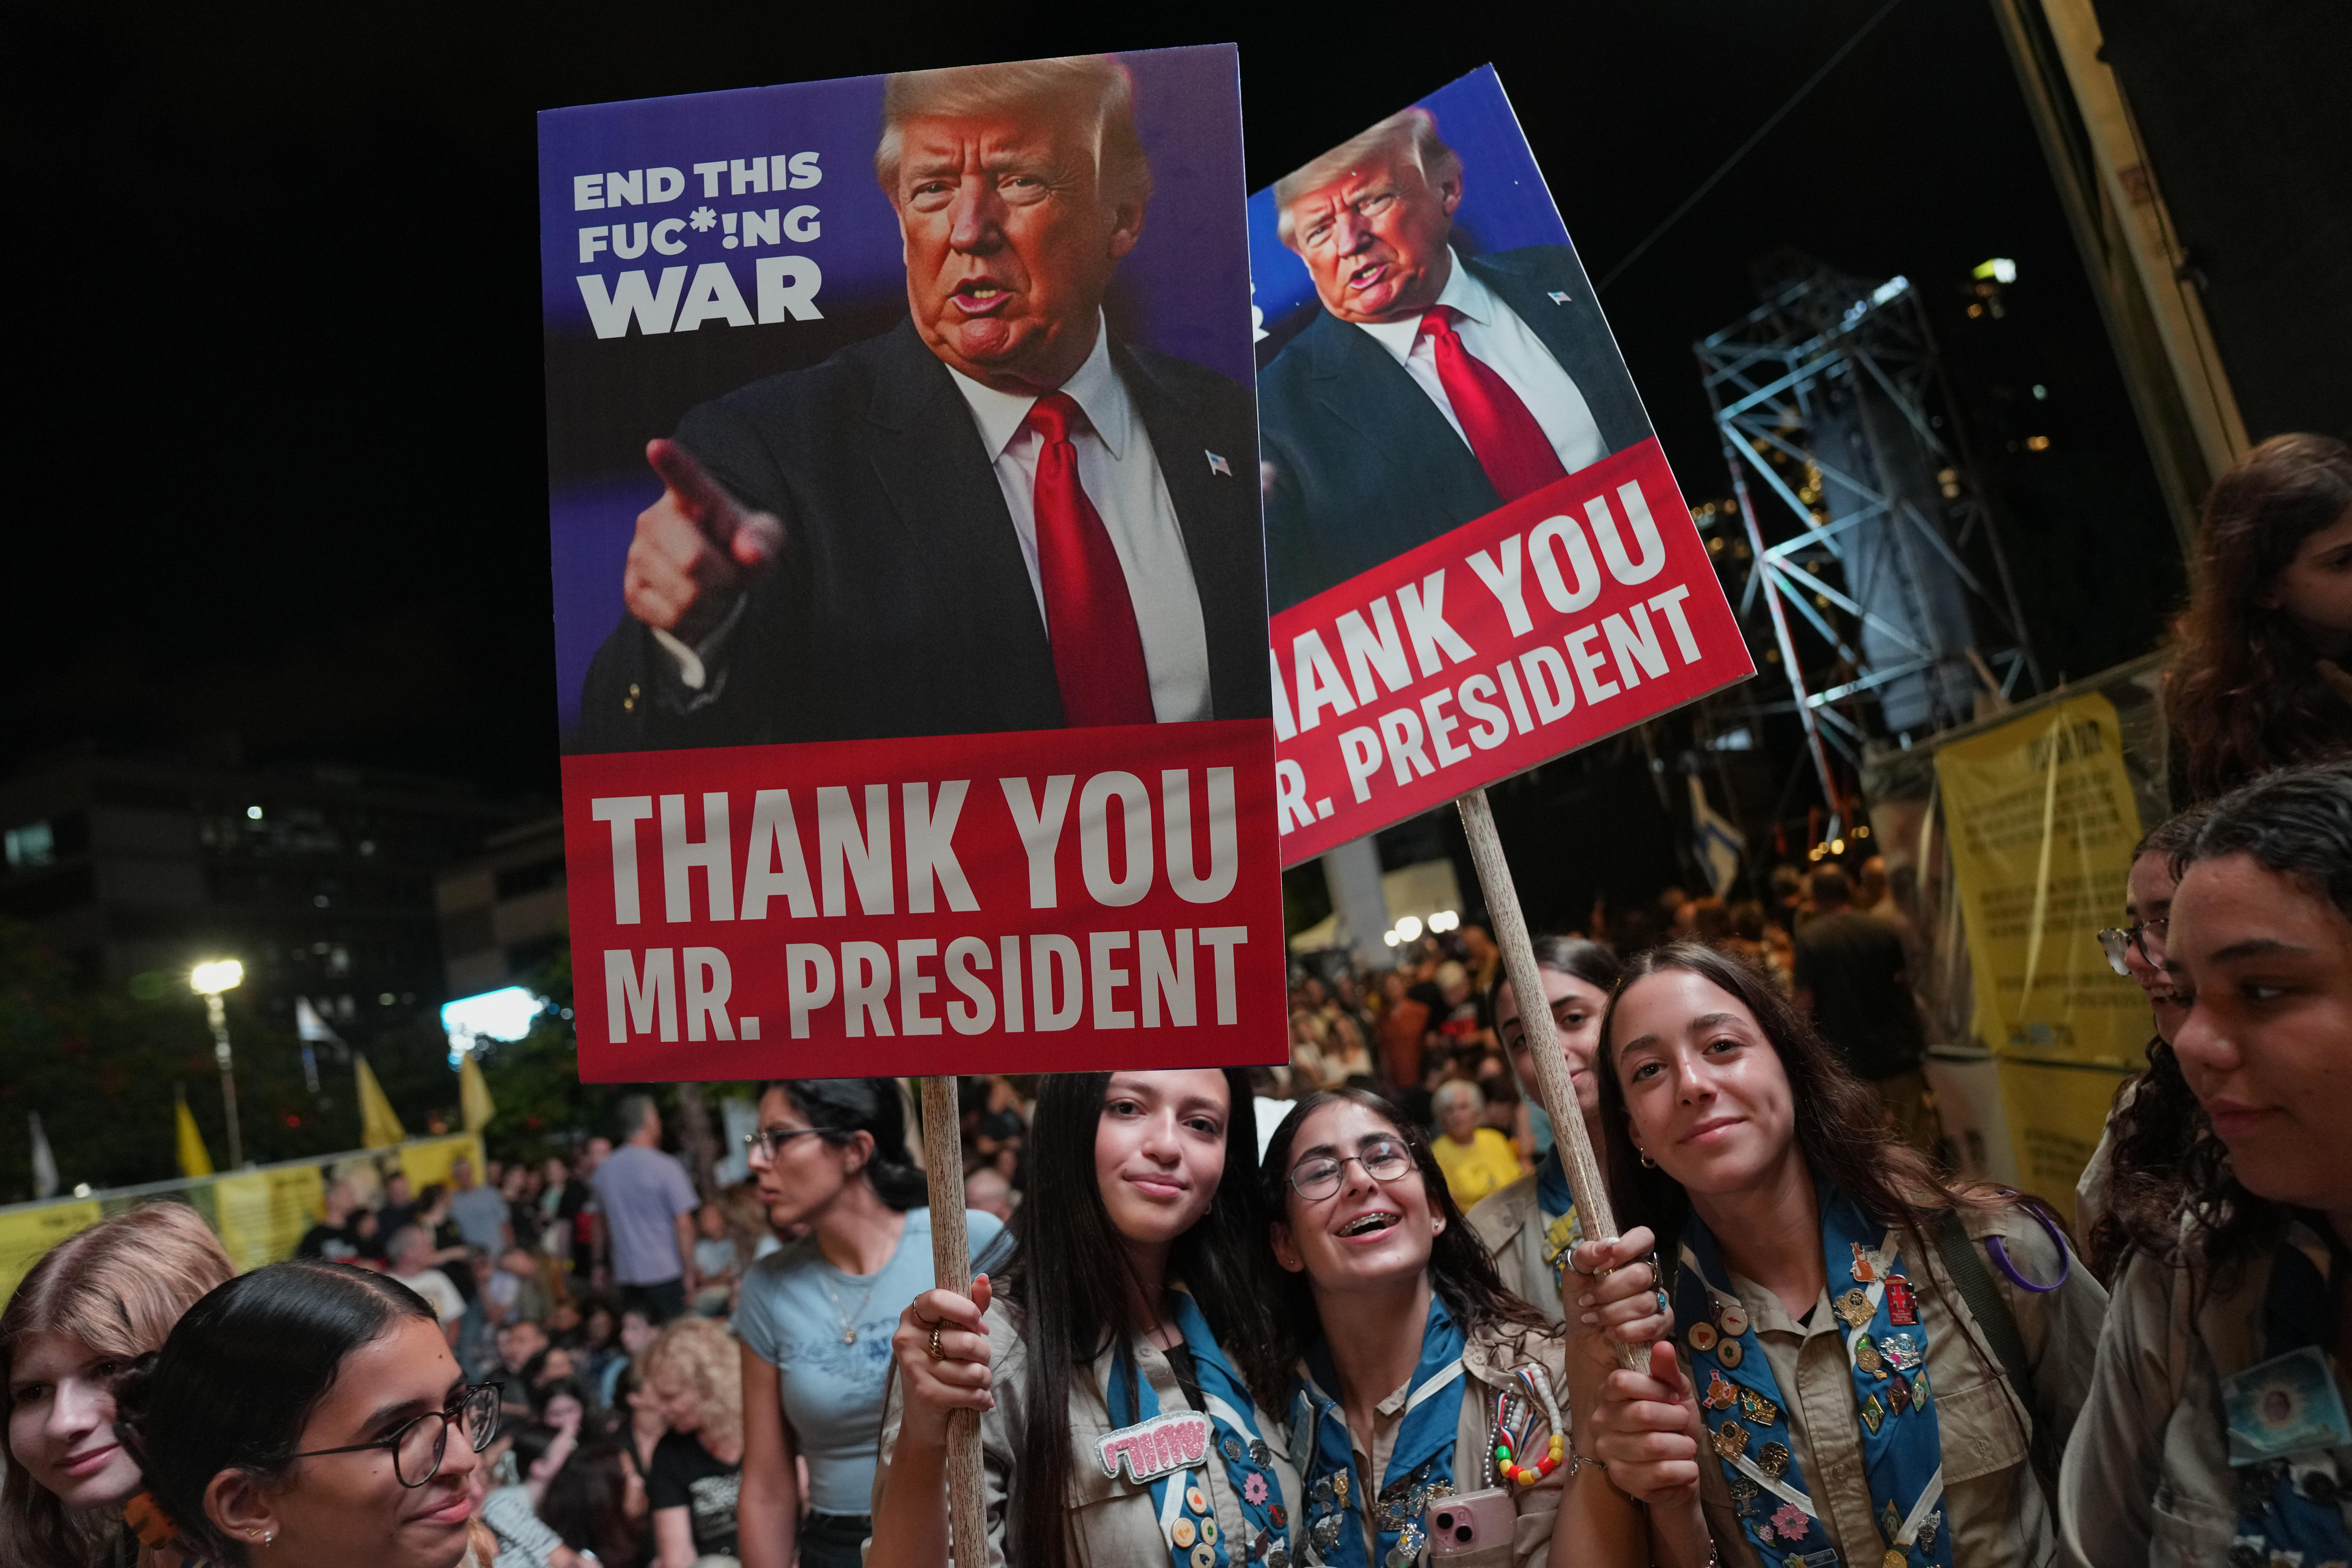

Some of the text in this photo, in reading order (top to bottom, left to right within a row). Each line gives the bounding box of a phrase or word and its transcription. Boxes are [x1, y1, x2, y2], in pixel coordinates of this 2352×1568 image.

[574, 152, 822, 211] END THIS
[576, 256, 824, 339] WAR
[1271, 479, 1665, 742] ANK YOU
[1278, 583, 1701, 836] R. PRESIDENT
[592, 767, 1238, 924] THANK YOU
[604, 926, 1248, 1043] MR. PRESIDENT
